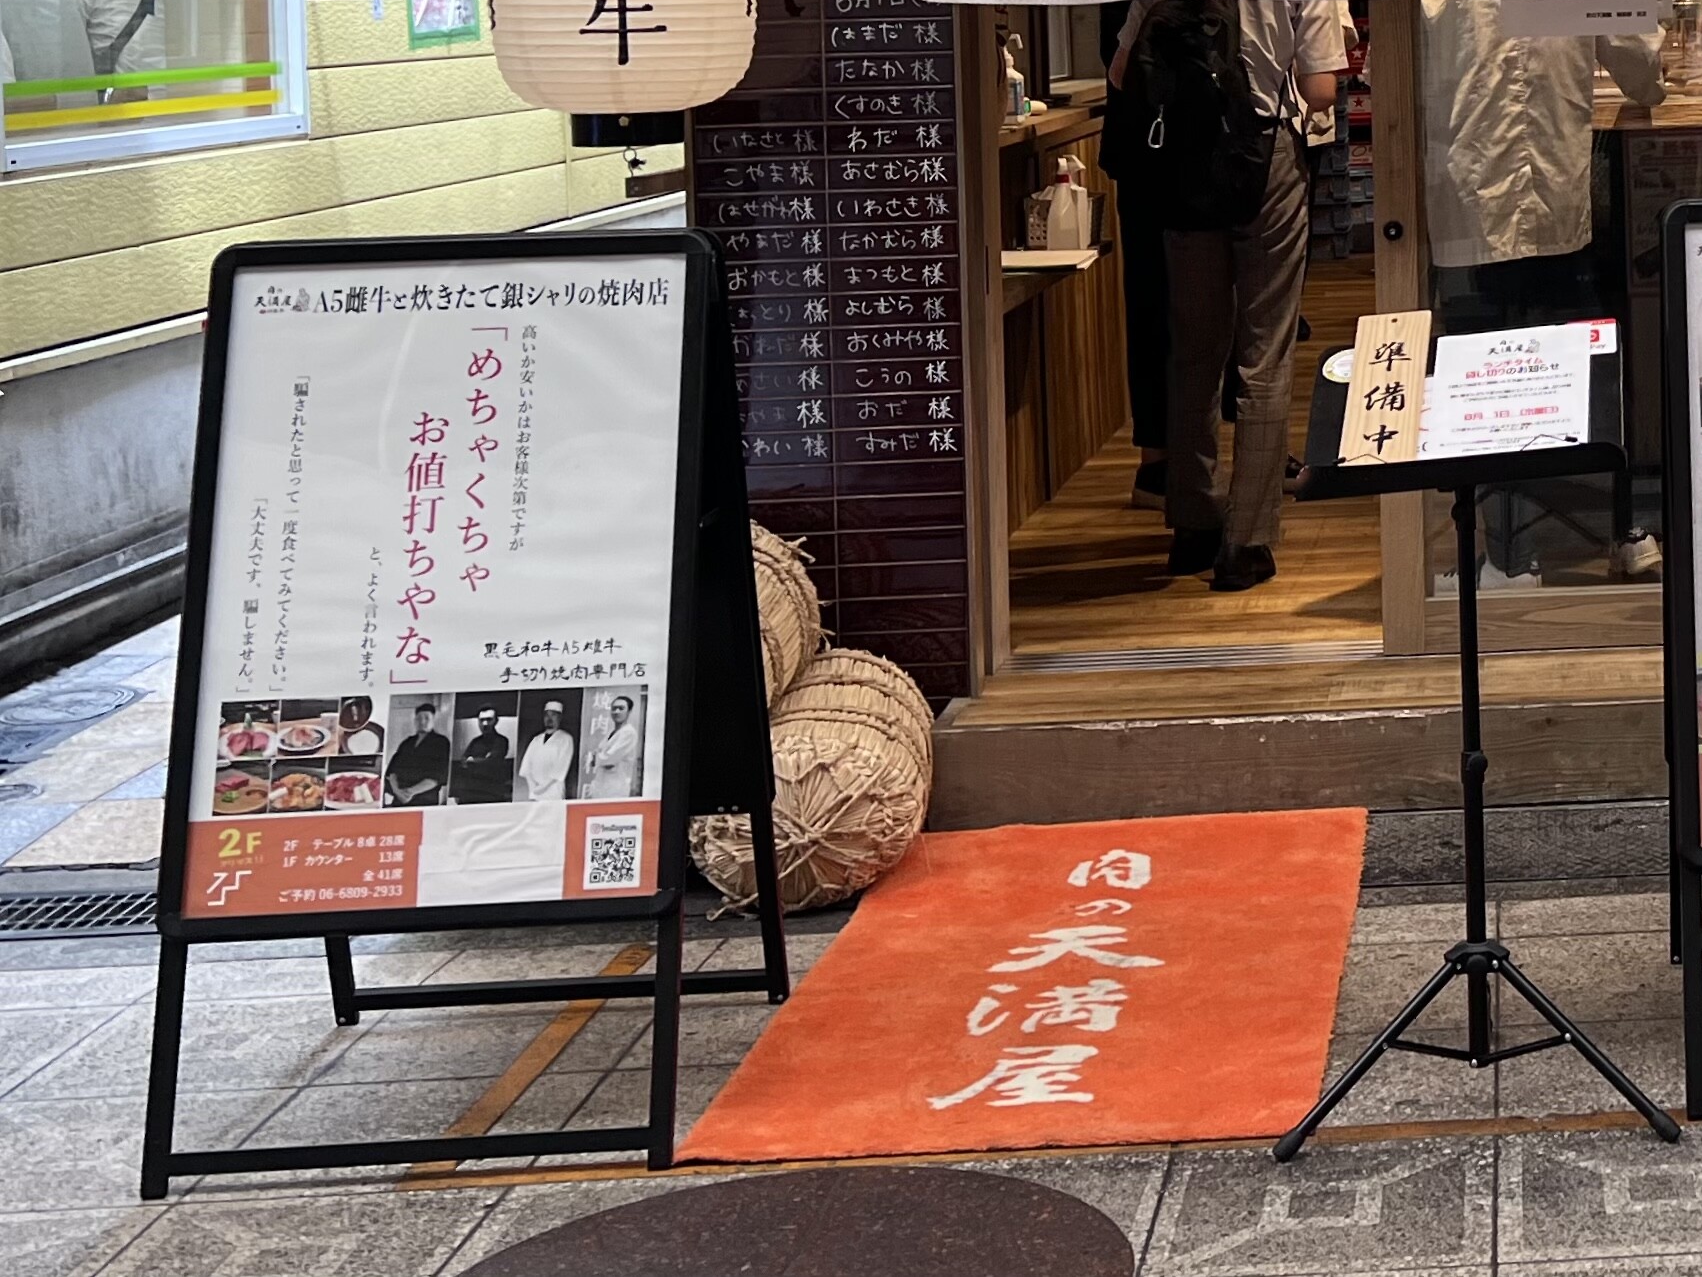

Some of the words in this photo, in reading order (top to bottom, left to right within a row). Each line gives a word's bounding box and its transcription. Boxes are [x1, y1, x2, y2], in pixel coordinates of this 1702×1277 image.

[312, 278, 670, 315] A5雌牛と炊きたて銀シャリの焼肉店
[1362, 341, 1413, 455] 準備中
[508, 323, 539, 553] 高いか安いかはお客様次第ですが
[218, 827, 263, 858] 2F
[283, 839, 299, 852] 2F
[312, 836, 354, 850] テーブル
[282, 855, 299, 868] 1F
[305, 854, 353, 867] カウンター
[279, 887, 315, 903] ご予約
[319, 884, 403, 900] 06-6809-2933
[926, 848, 1165, 1110] 肉の天満屋
